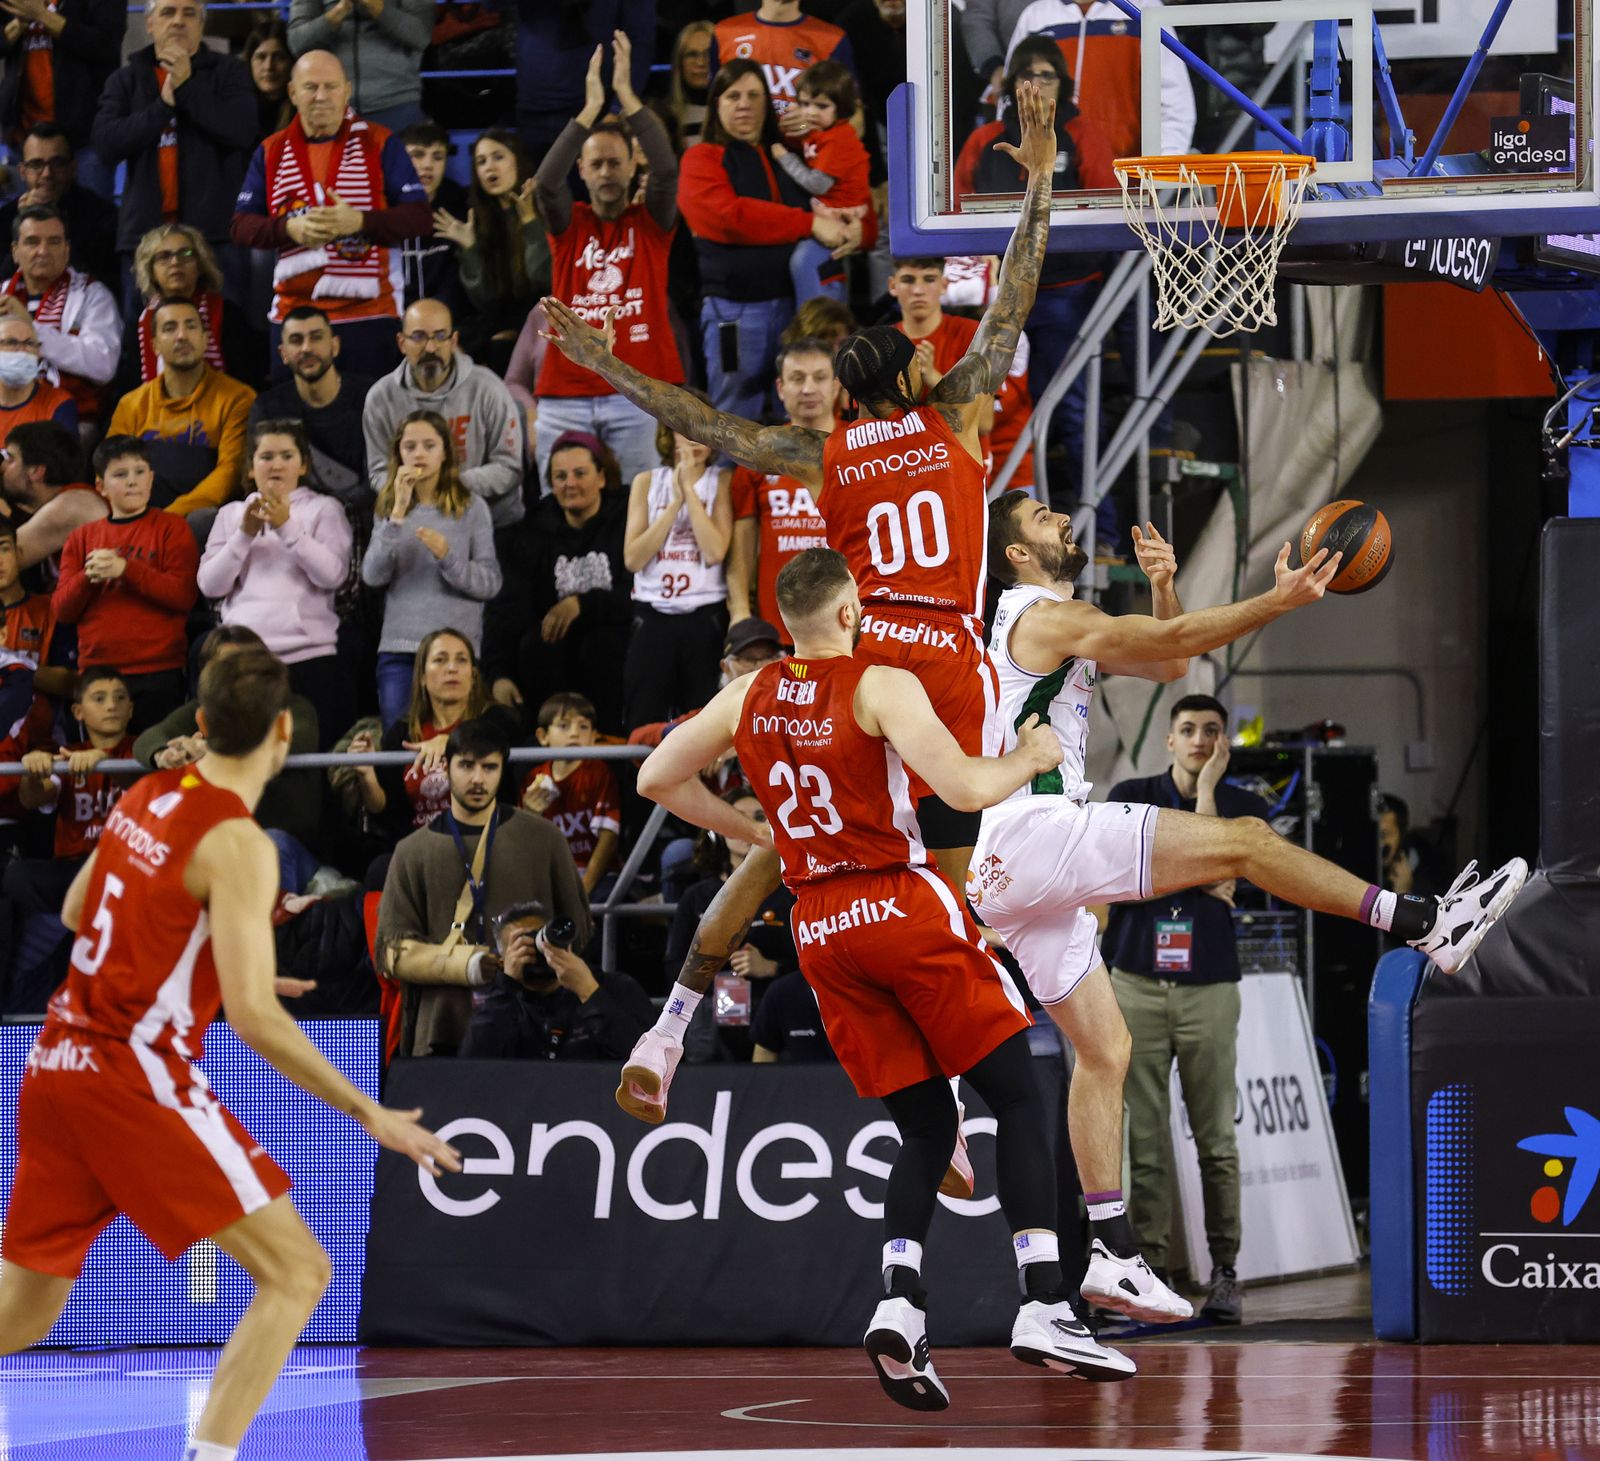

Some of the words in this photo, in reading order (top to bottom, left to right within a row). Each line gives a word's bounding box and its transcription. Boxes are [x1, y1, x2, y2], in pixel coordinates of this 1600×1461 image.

[1494, 131, 1527, 150] liga
[1494, 147, 1566, 164] endesa
[846, 411, 926, 450] ROBINSON
[836, 443, 949, 486] inmoovs
[907, 469, 918, 478] by
[918, 461, 951, 475] AVINENT
[866, 490, 951, 576] 00
[661, 572, 690, 599] 32
[889, 592, 935, 604] Manresa
[752, 712, 834, 737] inmoovs
[796, 739, 803, 748] by
[803, 738, 833, 747] AVINENT
[768, 760, 844, 840] 23
[70, 871, 125, 976] 5
[797, 896, 908, 950] Aquaflix
[1481, 1243, 1600, 1290] Caixa
